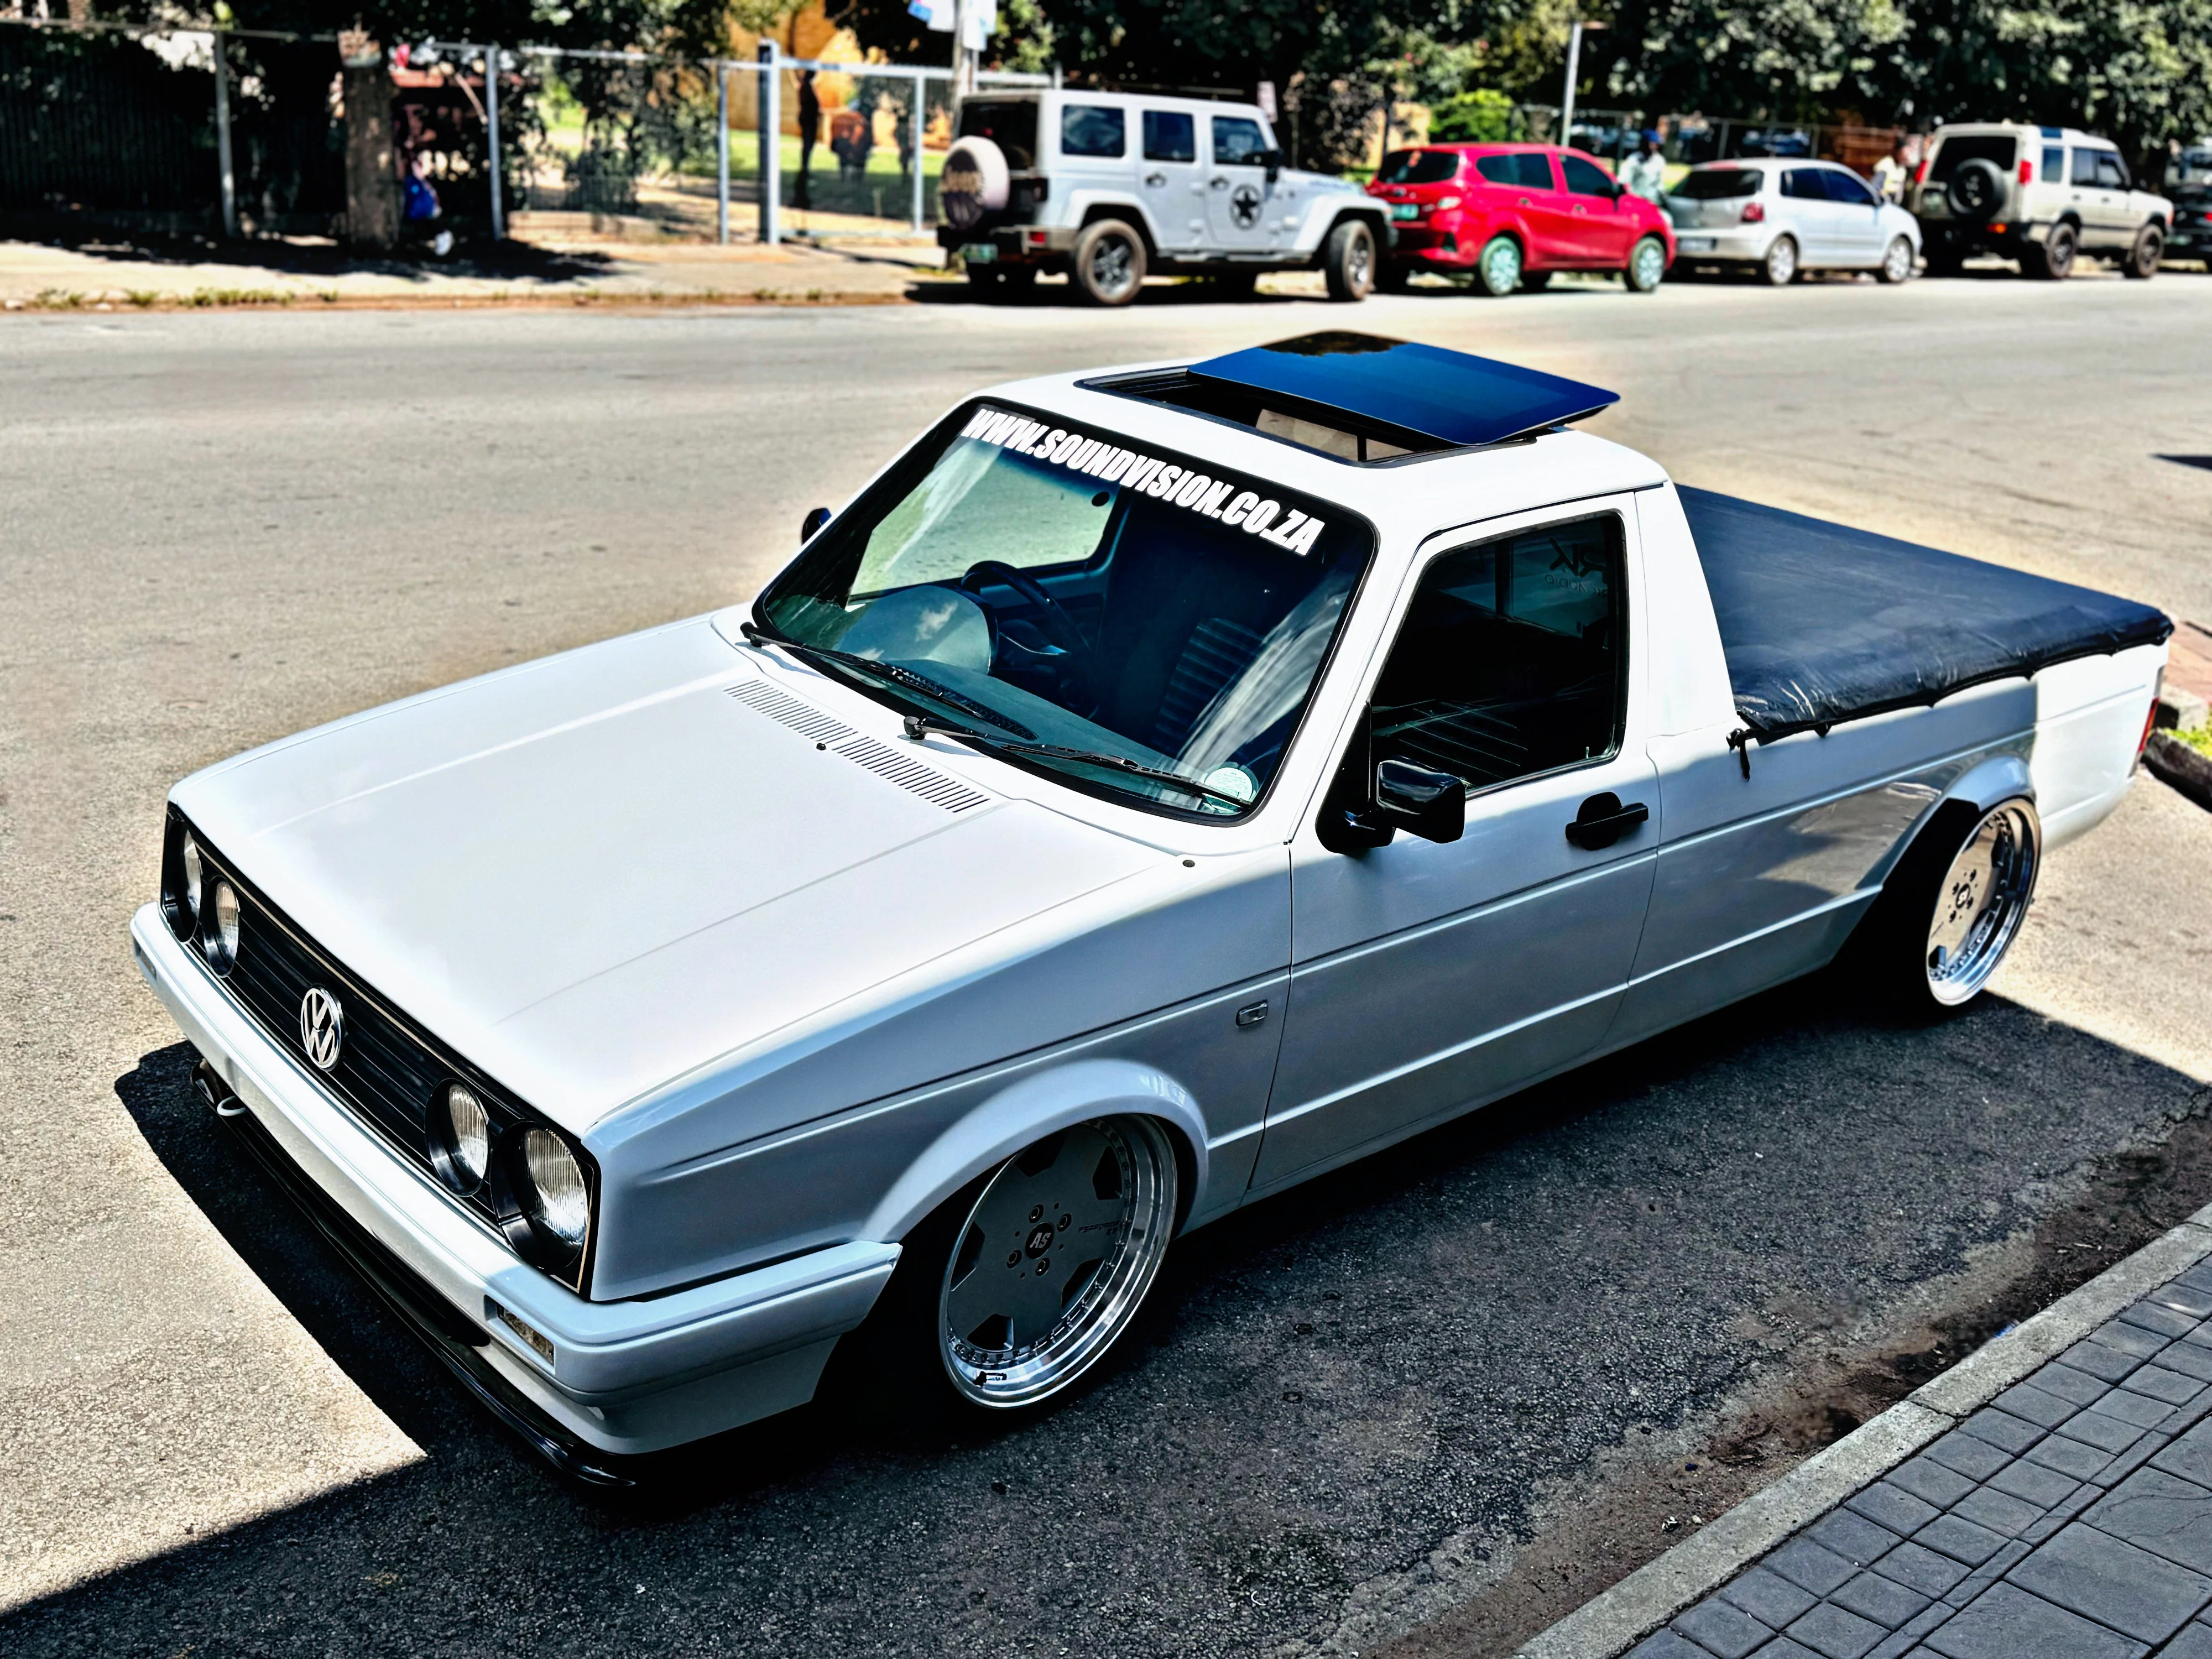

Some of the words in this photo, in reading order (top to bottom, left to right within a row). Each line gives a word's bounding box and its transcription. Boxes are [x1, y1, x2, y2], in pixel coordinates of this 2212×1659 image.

[961, 409, 1324, 555] WWW.SOUNDVISION.CO.ZA
[301, 987, 341, 1068] VW
[1029, 1232, 1051, 1248] AS
